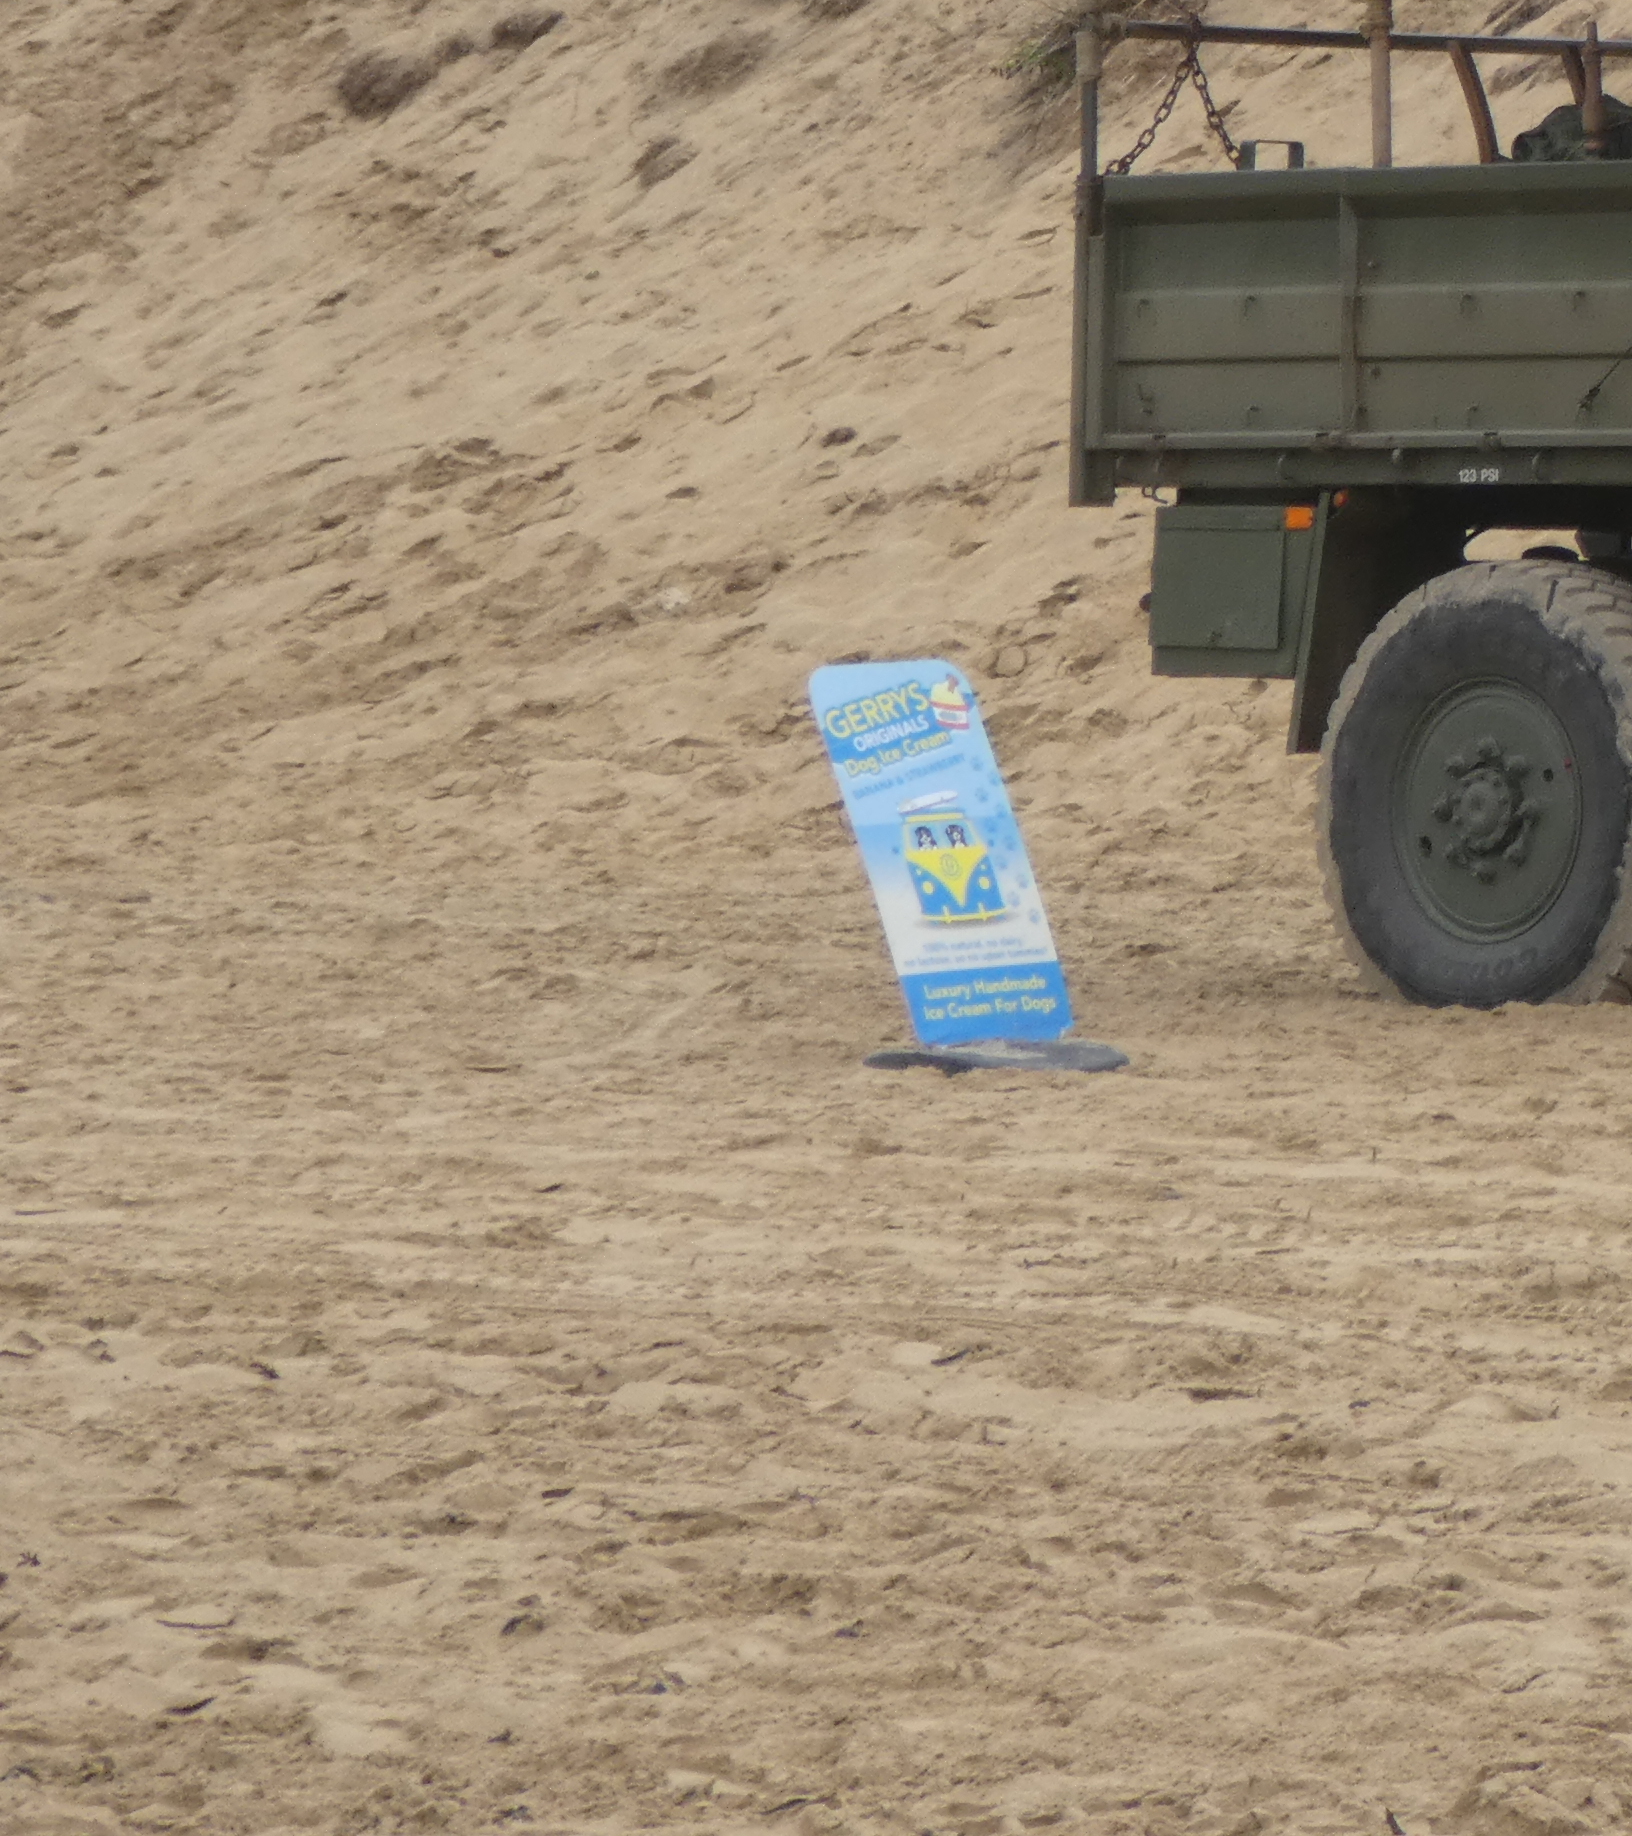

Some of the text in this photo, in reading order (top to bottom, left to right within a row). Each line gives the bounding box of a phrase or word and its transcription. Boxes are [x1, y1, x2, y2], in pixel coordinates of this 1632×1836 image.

[1459, 468, 1499, 483] 123 PSI
[825, 682, 930, 738] GERRYS
[853, 715, 929, 752] ORIGINALS
[844, 758, 881, 776] Dog
[902, 732, 950, 755] Cream
[923, 975, 1046, 1000] Luxury Handmade
[924, 995, 1056, 1020] Ice Cream For Dogs
